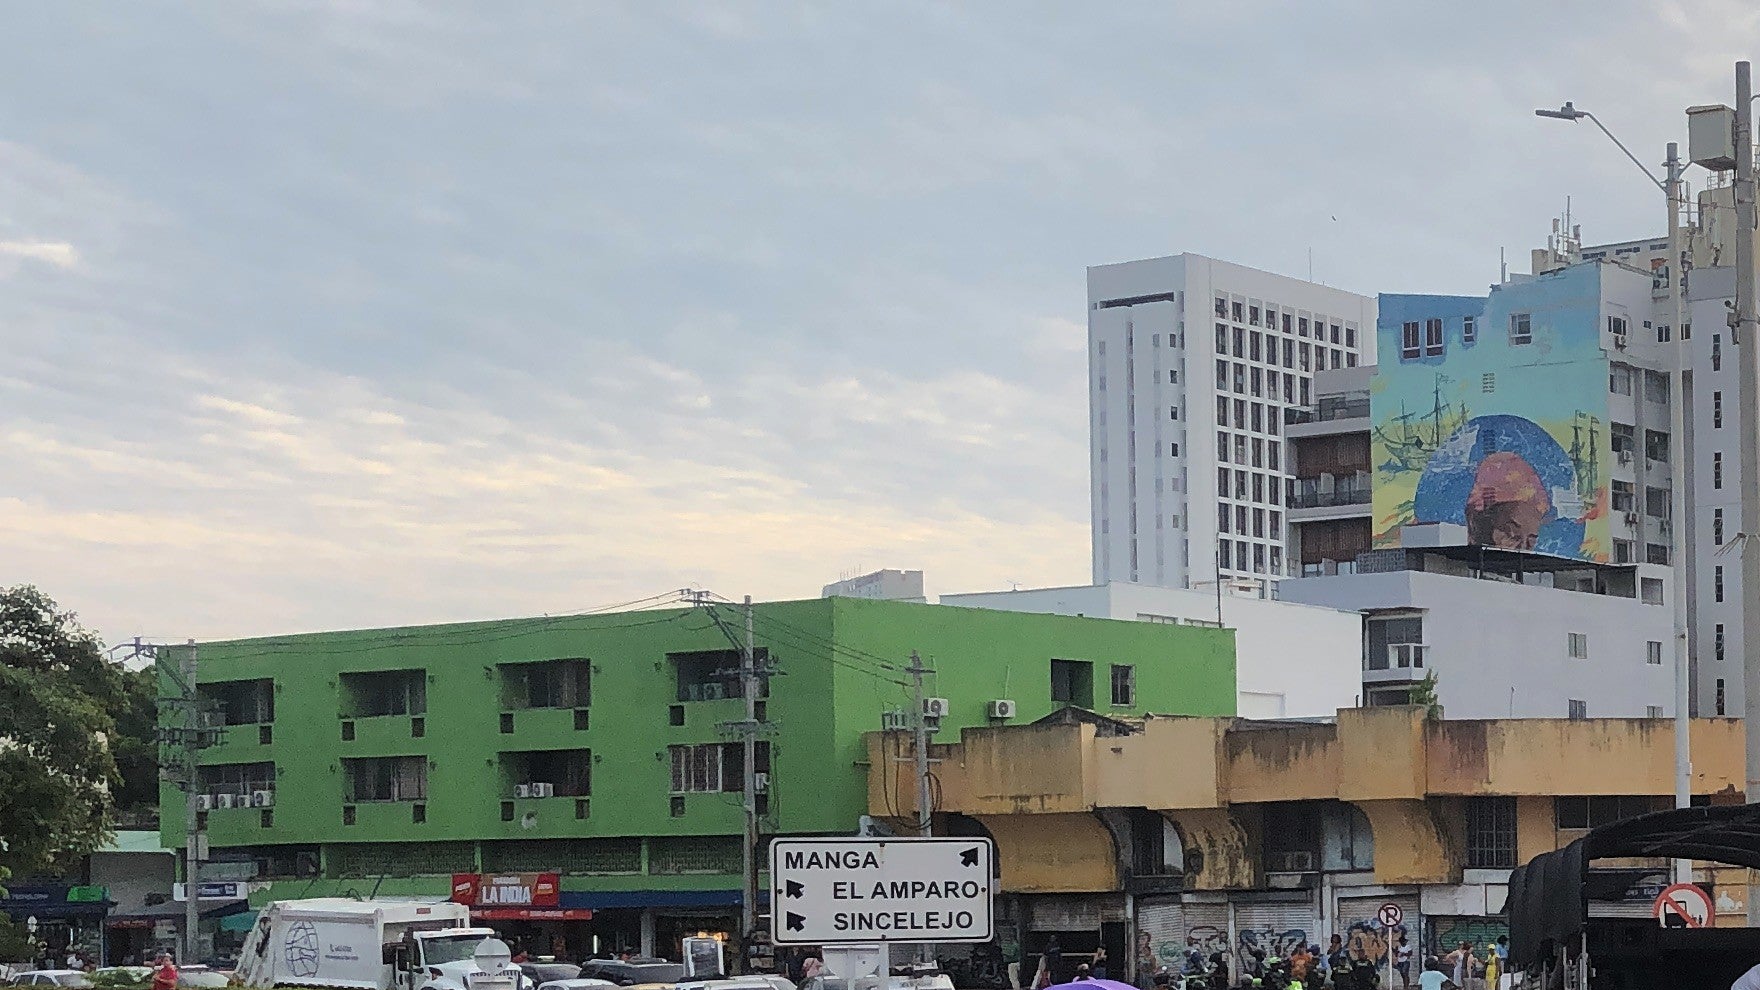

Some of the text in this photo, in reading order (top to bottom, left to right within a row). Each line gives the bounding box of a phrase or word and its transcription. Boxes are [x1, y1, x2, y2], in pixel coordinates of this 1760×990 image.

[785, 851, 880, 869] MANGA
[482, 886, 499, 904] LA
[499, 885, 531, 904] INDIA
[833, 880, 979, 900] EL AMPARO
[833, 911, 973, 931] SINCELEJO
